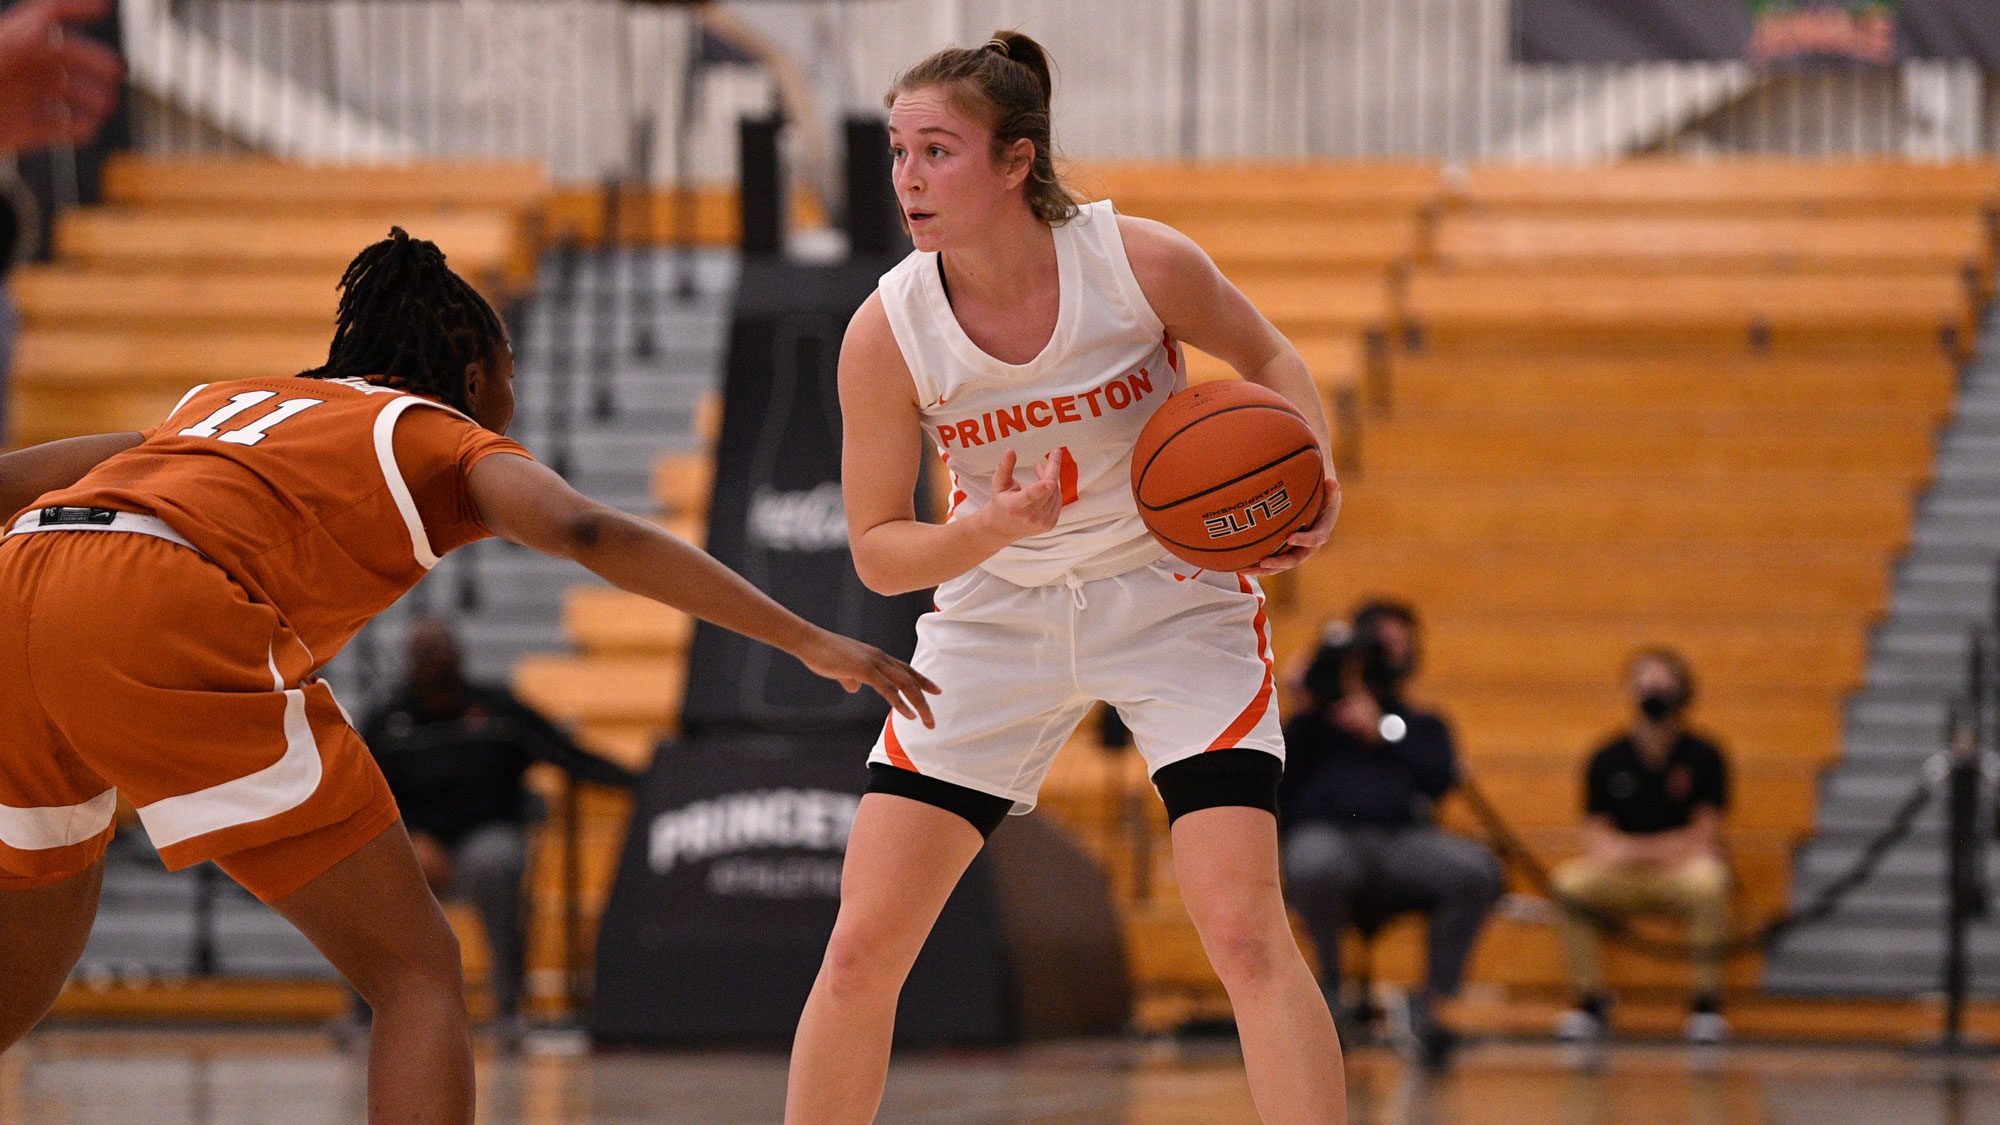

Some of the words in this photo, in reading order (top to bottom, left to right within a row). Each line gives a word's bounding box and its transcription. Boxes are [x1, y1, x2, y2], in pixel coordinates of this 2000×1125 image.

[176, 390, 327, 447] 11
[936, 367, 1154, 449] PRINCETON
[1202, 480, 1285, 519] CHAMPIONSHIP
[1203, 487, 1292, 540] ELITE
